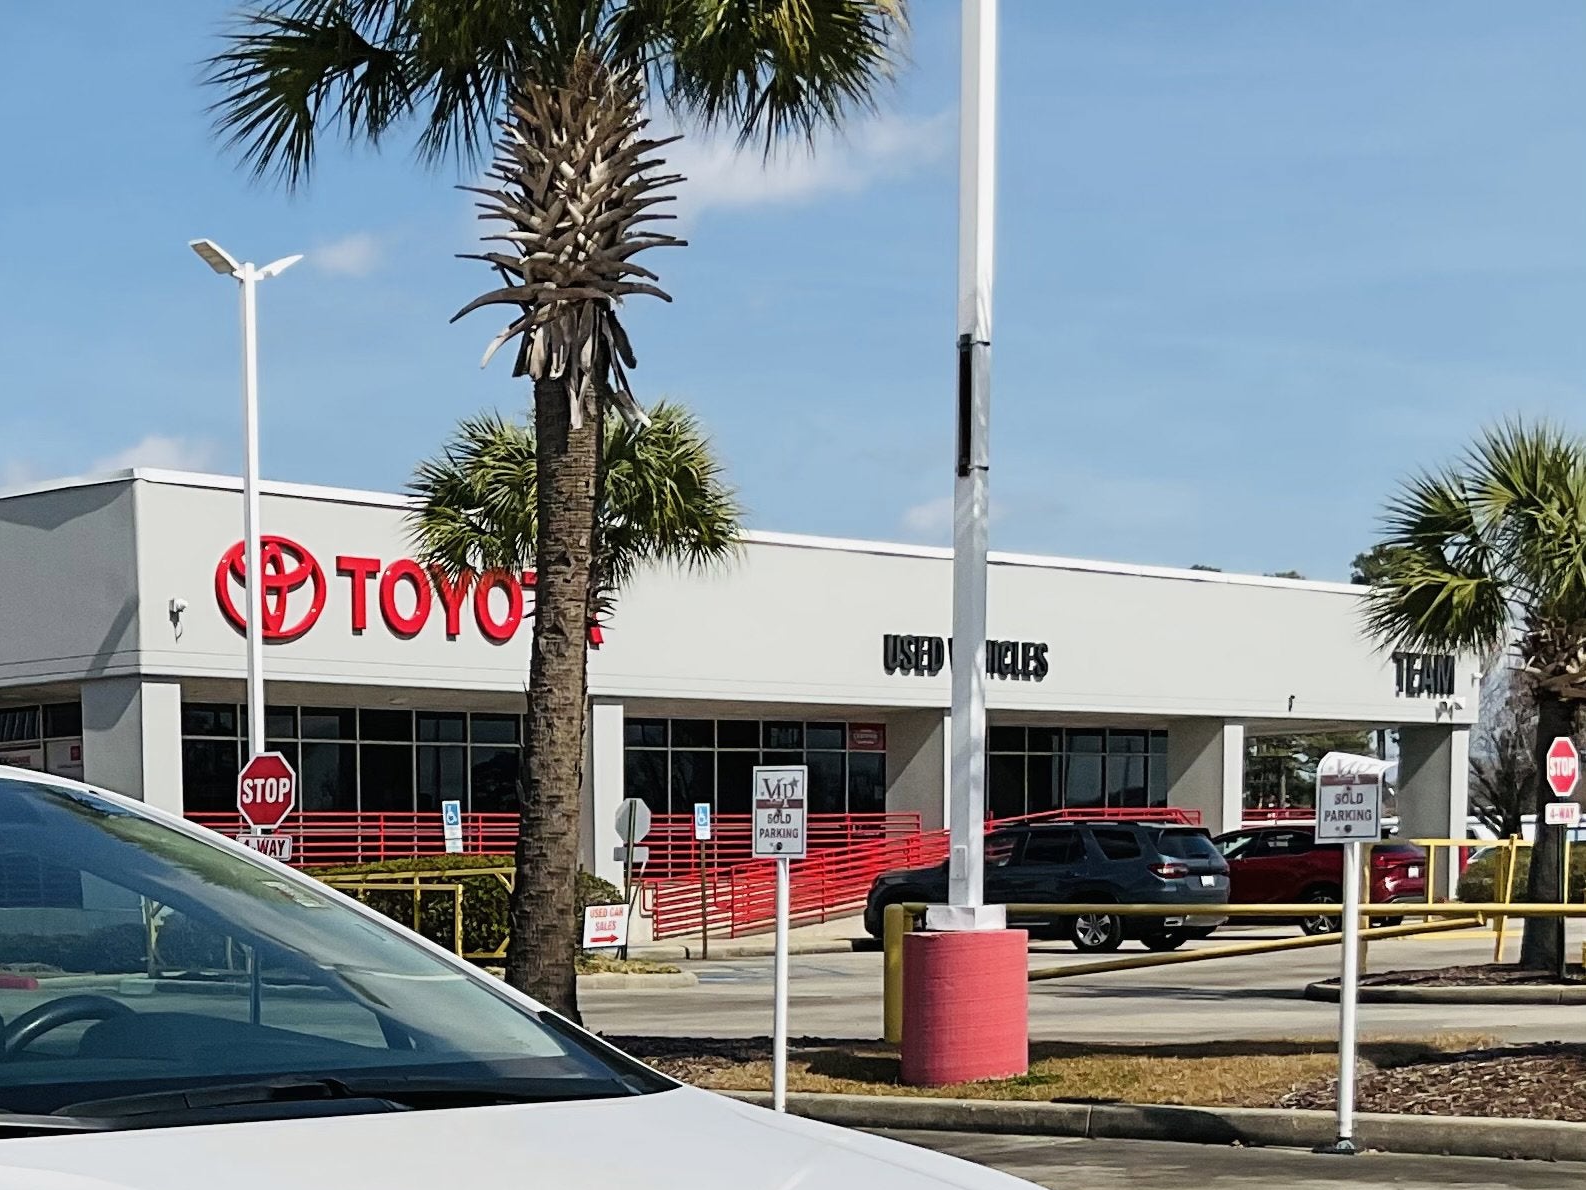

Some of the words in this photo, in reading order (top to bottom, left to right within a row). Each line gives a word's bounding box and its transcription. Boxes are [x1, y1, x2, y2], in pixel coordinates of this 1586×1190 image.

[336, 555, 604, 645] TOYO
[883, 634, 945, 675] USED
[948, 638, 1048, 681] ICLES
[1392, 651, 1455, 697] TEAM
[1549, 756, 1576, 777] STOP
[242, 777, 291, 804] STOP
[1334, 792, 1364, 805] SOLD
[767, 813, 792, 824] SOLD
[1324, 809, 1373, 822] PARKING
[1549, 808, 1575, 819] 4-WAY
[759, 828, 799, 838] PARKING
[590, 908, 607, 918] USED
[610, 907, 623, 917] CAR
[595, 920, 617, 931] SALES
